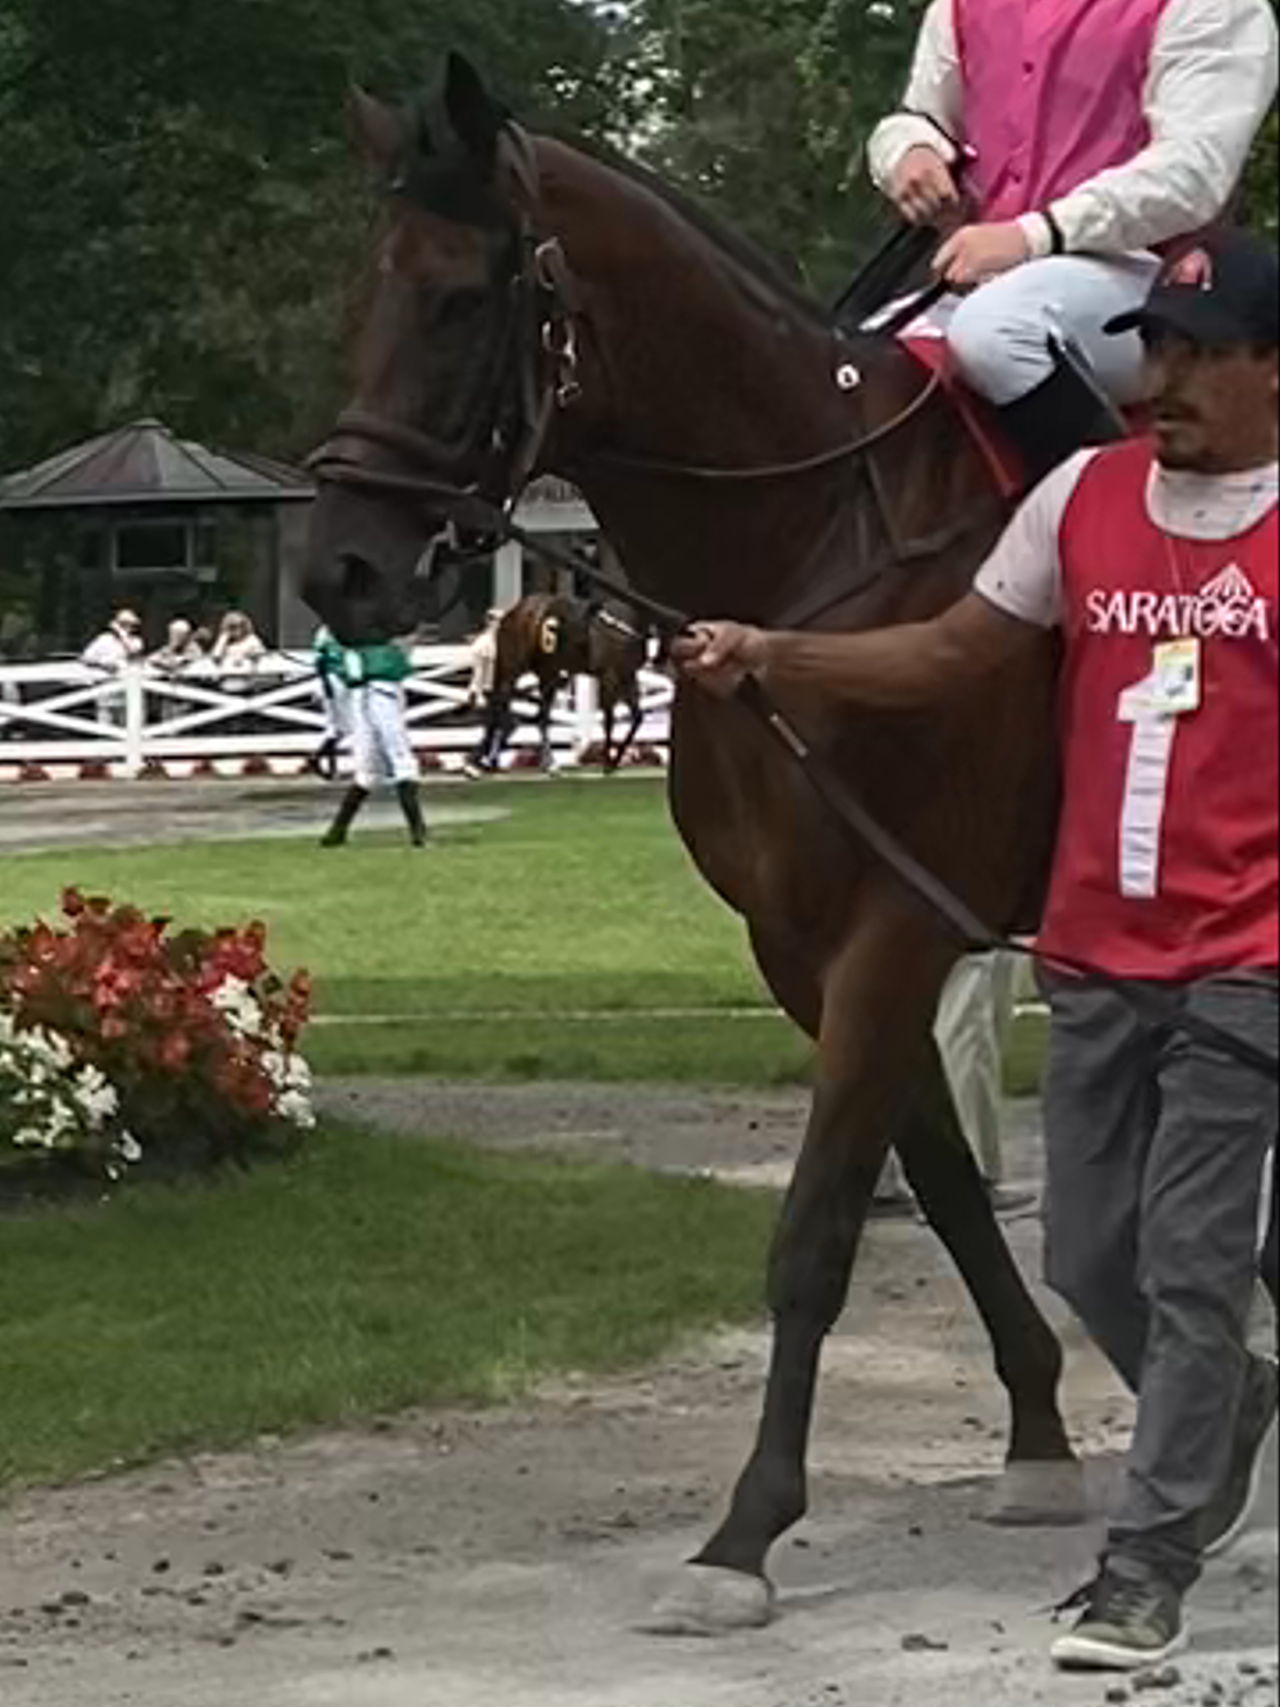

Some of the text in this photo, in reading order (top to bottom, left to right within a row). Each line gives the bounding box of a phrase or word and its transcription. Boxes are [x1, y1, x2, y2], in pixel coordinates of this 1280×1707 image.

[541, 617, 558, 653] 6
[1086, 590, 1269, 641] SARATOGA
[1117, 669, 1176, 897] 1
